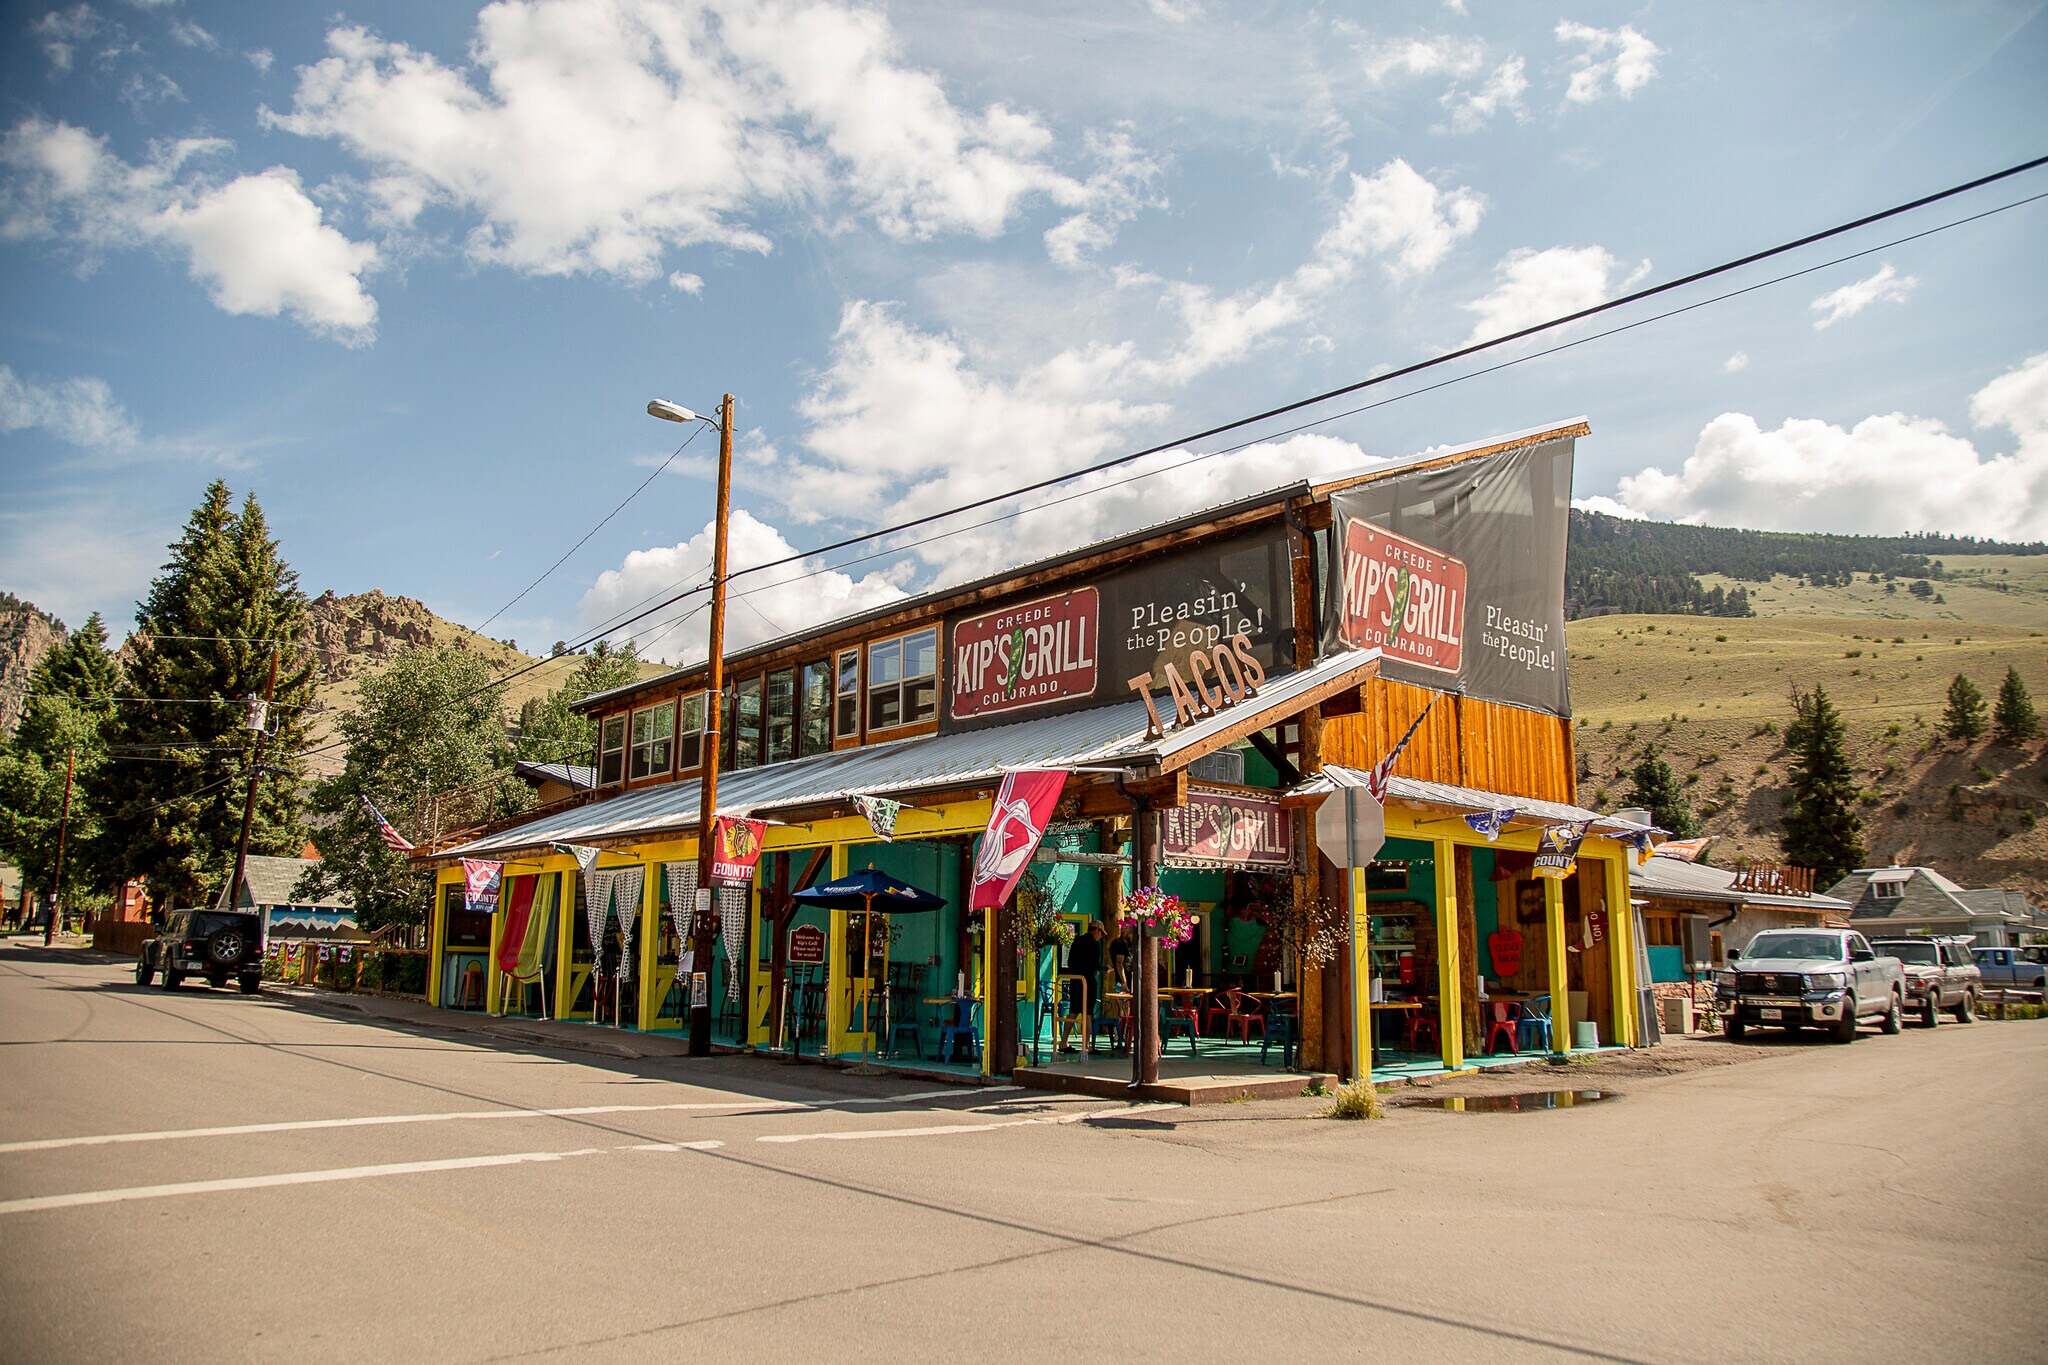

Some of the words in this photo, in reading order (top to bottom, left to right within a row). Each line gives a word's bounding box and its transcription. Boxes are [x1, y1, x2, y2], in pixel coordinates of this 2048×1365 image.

[1386, 544, 1433, 573] CREEDE
[997, 606, 1051, 630] CREEDE
[1345, 550, 1398, 628] KIP'S
[1403, 573, 1459, 646] GRILL
[1126, 634, 1155, 650] the
[1157, 607, 1264, 652] People!
[1365, 628, 1433, 658] COLORADO
[957, 633, 1012, 695] KIP'S
[1021, 616, 1093, 681] GRILL
[1482, 631, 1500, 648] the
[1500, 636, 1555, 671] People!
[983, 680, 1058, 706] COLORADO
[1127, 634, 1265, 735] TACOS
[1168, 802, 1221, 849] KIP'S
[1231, 806, 1286, 854] GRILL
